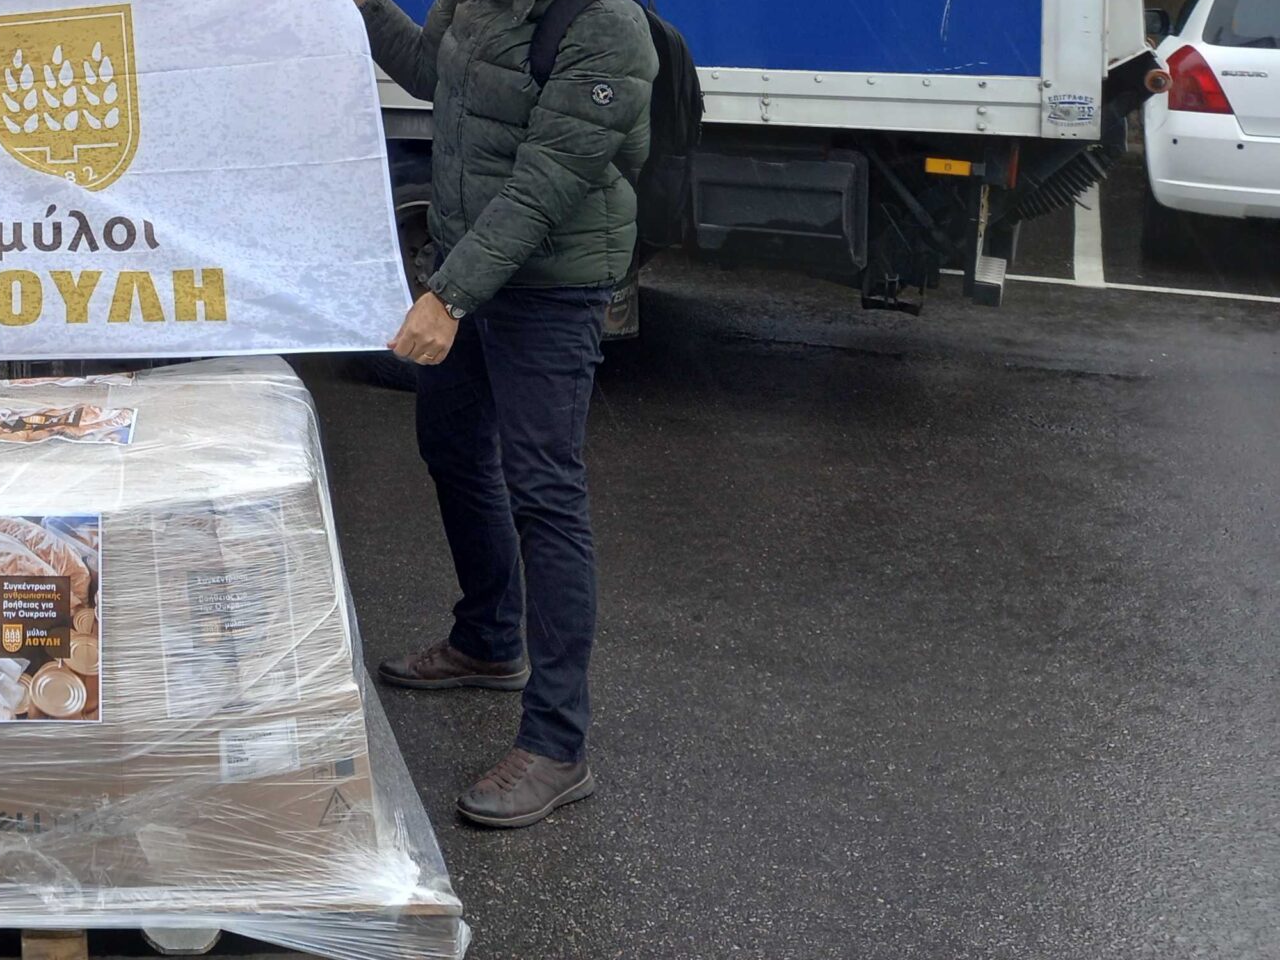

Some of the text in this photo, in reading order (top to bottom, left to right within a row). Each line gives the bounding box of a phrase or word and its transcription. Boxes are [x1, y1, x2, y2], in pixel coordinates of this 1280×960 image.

[3, 582, 57, 591] Συγκέντρωση
[3, 592, 61, 600] ανθρωπιστικής
[2, 600, 39, 609] βοήθειας
[2, 610, 57, 619] την Ουκρανία
[26, 628, 48, 638] μύλοι
[24, 637, 61, 646] ΛΟΥΛΗ
